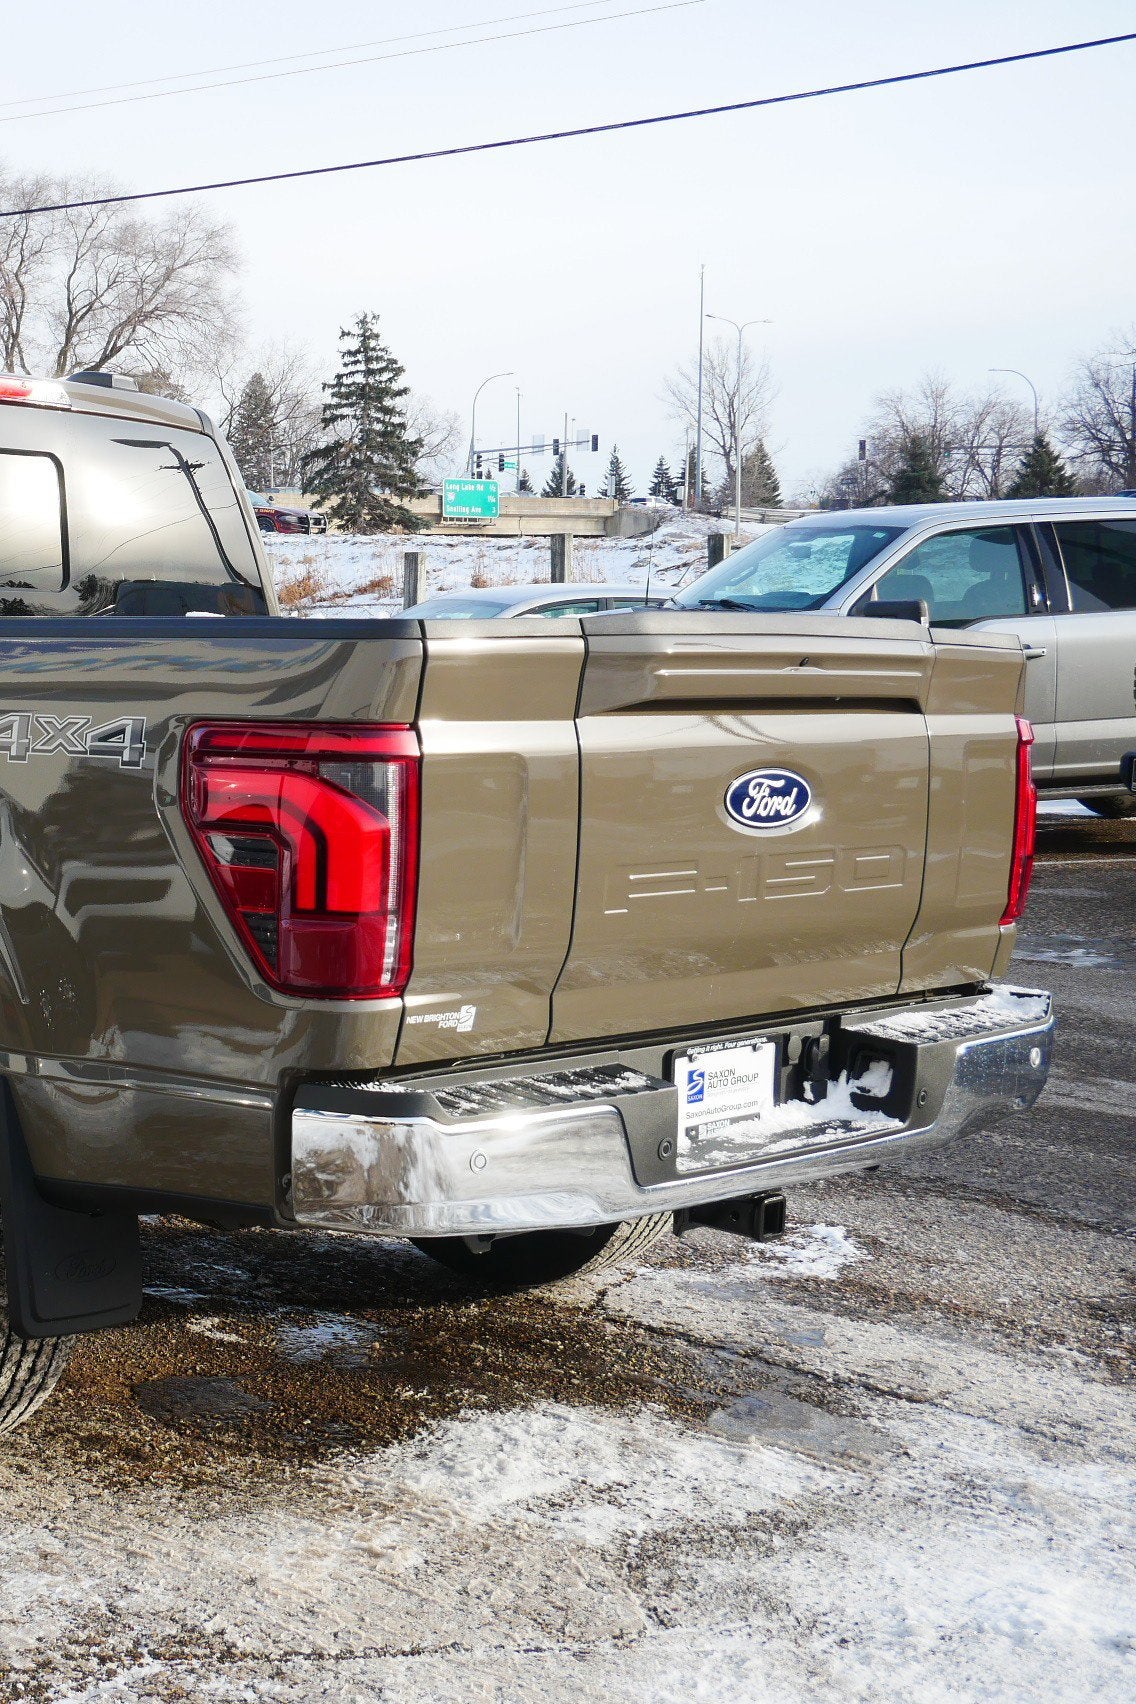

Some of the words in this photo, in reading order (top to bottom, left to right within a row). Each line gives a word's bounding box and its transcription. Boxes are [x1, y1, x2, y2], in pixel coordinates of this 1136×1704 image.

[446, 483, 460, 492] Long
[446, 505, 470, 515] Snelling
[742, 777, 798, 817] Ford
[603, 844, 907, 914] F-150
[406, 1015, 424, 1024] NEW
[424, 1012, 461, 1022] BRIGHTON
[438, 1020, 458, 1029] FORD
[686, 1046, 705, 1056] Getting
[710, 1043, 723, 1051] right.
[707, 1068, 736, 1080] SAXON
[707, 1078, 728, 1089] AUTO
[730, 1073, 759, 1085] GROUP
[686, 1100, 759, 1120] SaxonAutoGroup.com
